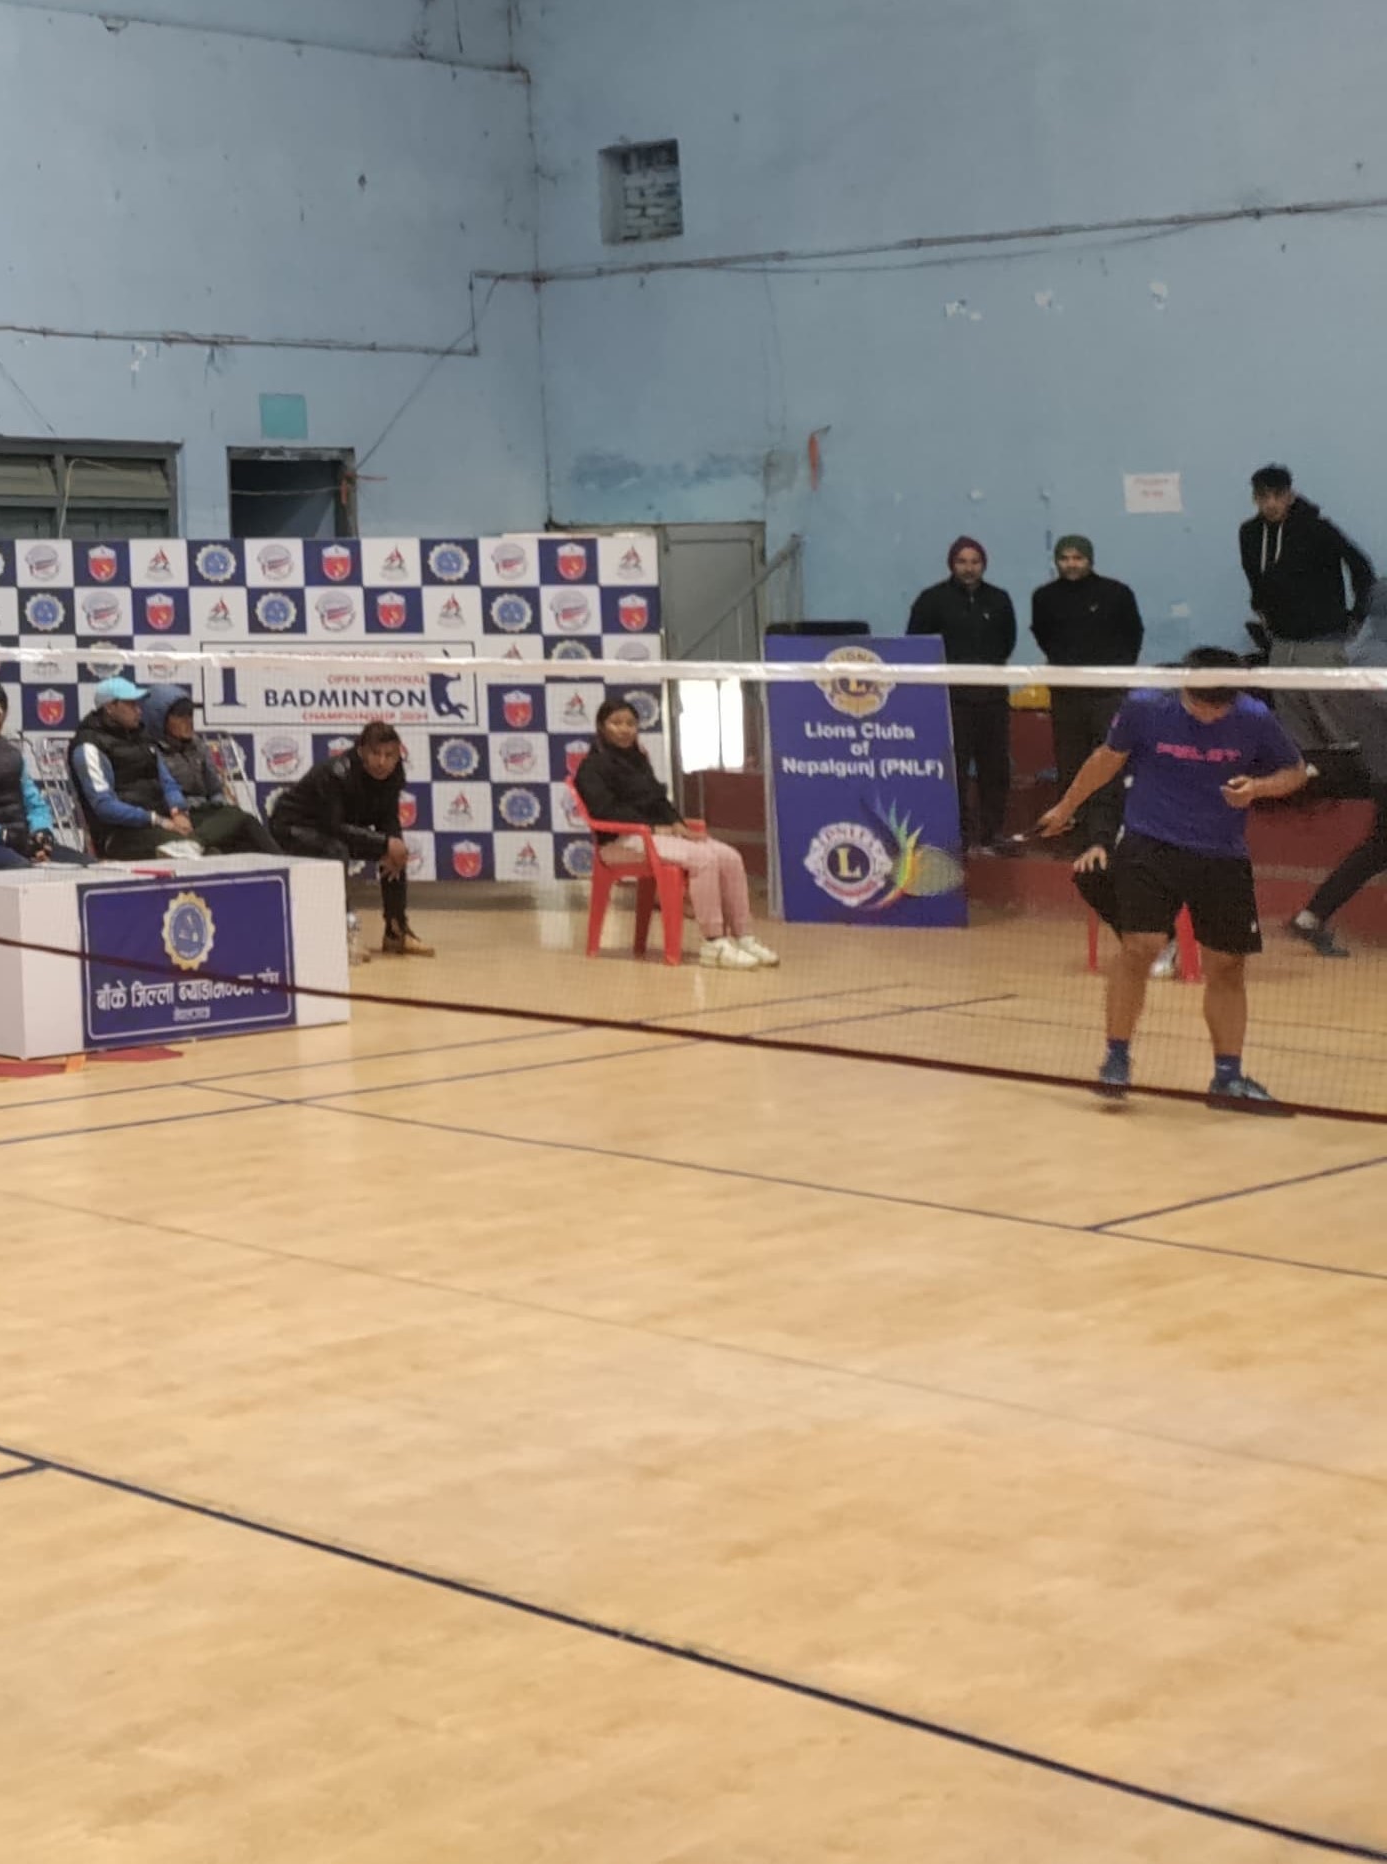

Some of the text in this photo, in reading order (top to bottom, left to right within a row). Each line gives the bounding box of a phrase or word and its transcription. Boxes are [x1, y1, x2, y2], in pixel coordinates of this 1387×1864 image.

[264, 688, 427, 708] BADMINTON
[804, 721, 915, 740] Lions Clubs
[850, 740, 871, 756] of
[782, 757, 944, 780] Nepalgunj (PNLF)
